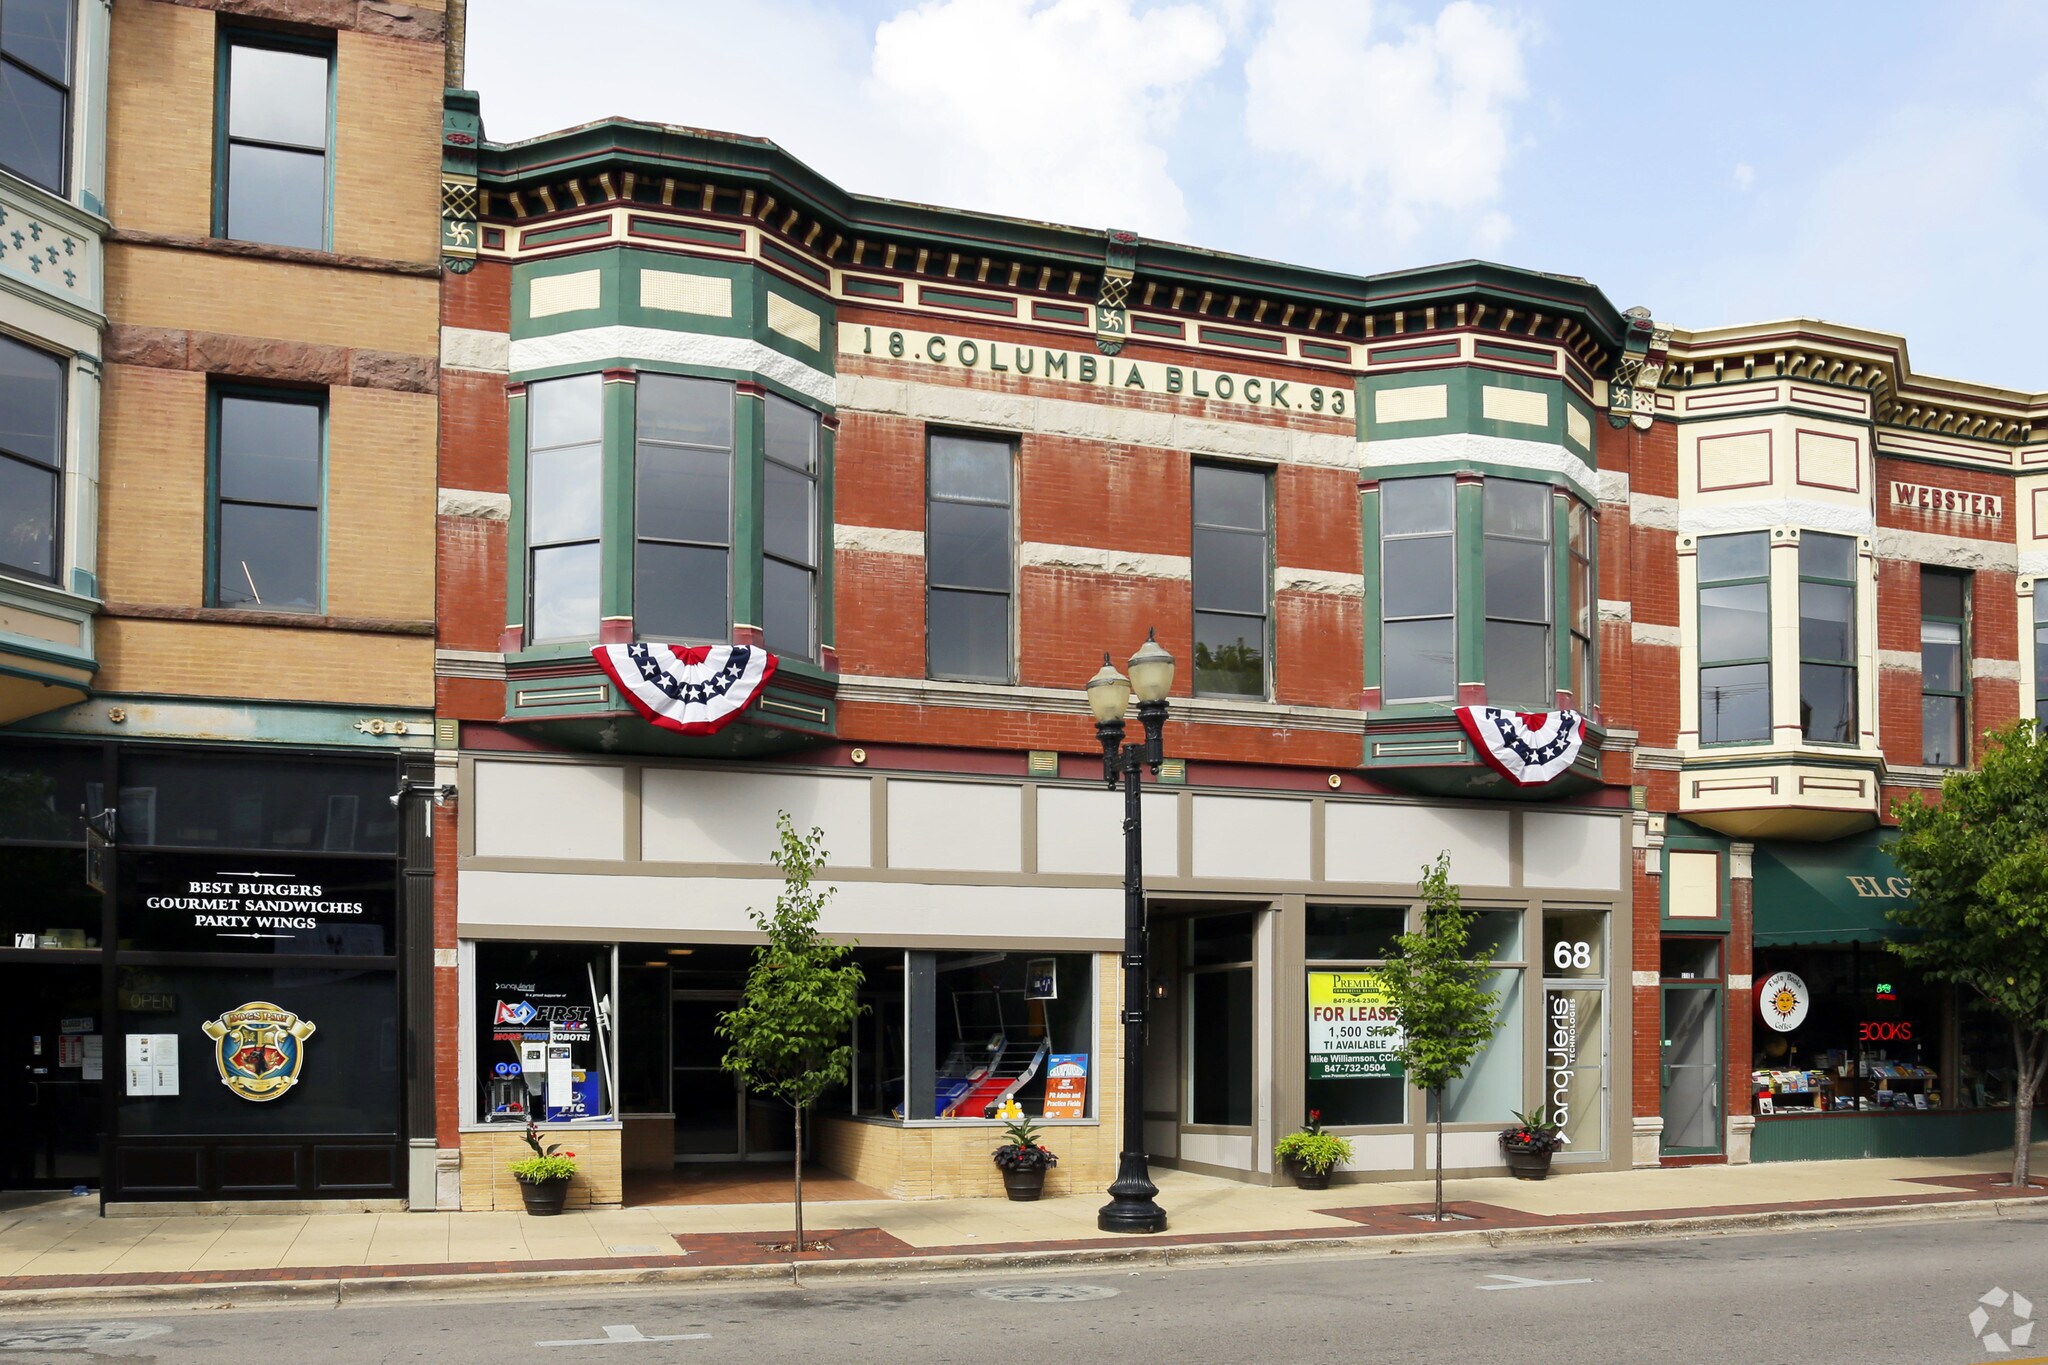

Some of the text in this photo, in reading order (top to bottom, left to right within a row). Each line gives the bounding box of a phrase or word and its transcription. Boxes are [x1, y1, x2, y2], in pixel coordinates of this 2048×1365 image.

[189, 881, 322, 897] BEST BURGERS
[1845, 875, 1913, 898] ELG
[146, 897, 363, 914] GOURMET SANDWICHES
[194, 914, 316, 929] PARTY WINGS
[1553, 940, 1591, 969] 68
[130, 993, 173, 1009] OPEN
[1314, 1006, 1396, 1021] FOR LEASE
[1328, 1026, 1361, 1039] 1,500
[1859, 1022, 1911, 1041] BOOKS
[1324, 1040, 1386, 1050] TI AVAILABLE
[1310, 1054, 1328, 1063] Mike
[1330, 1053, 1377, 1063] Williamson,
[1324, 1063, 1386, 1073] 847-732-0504
